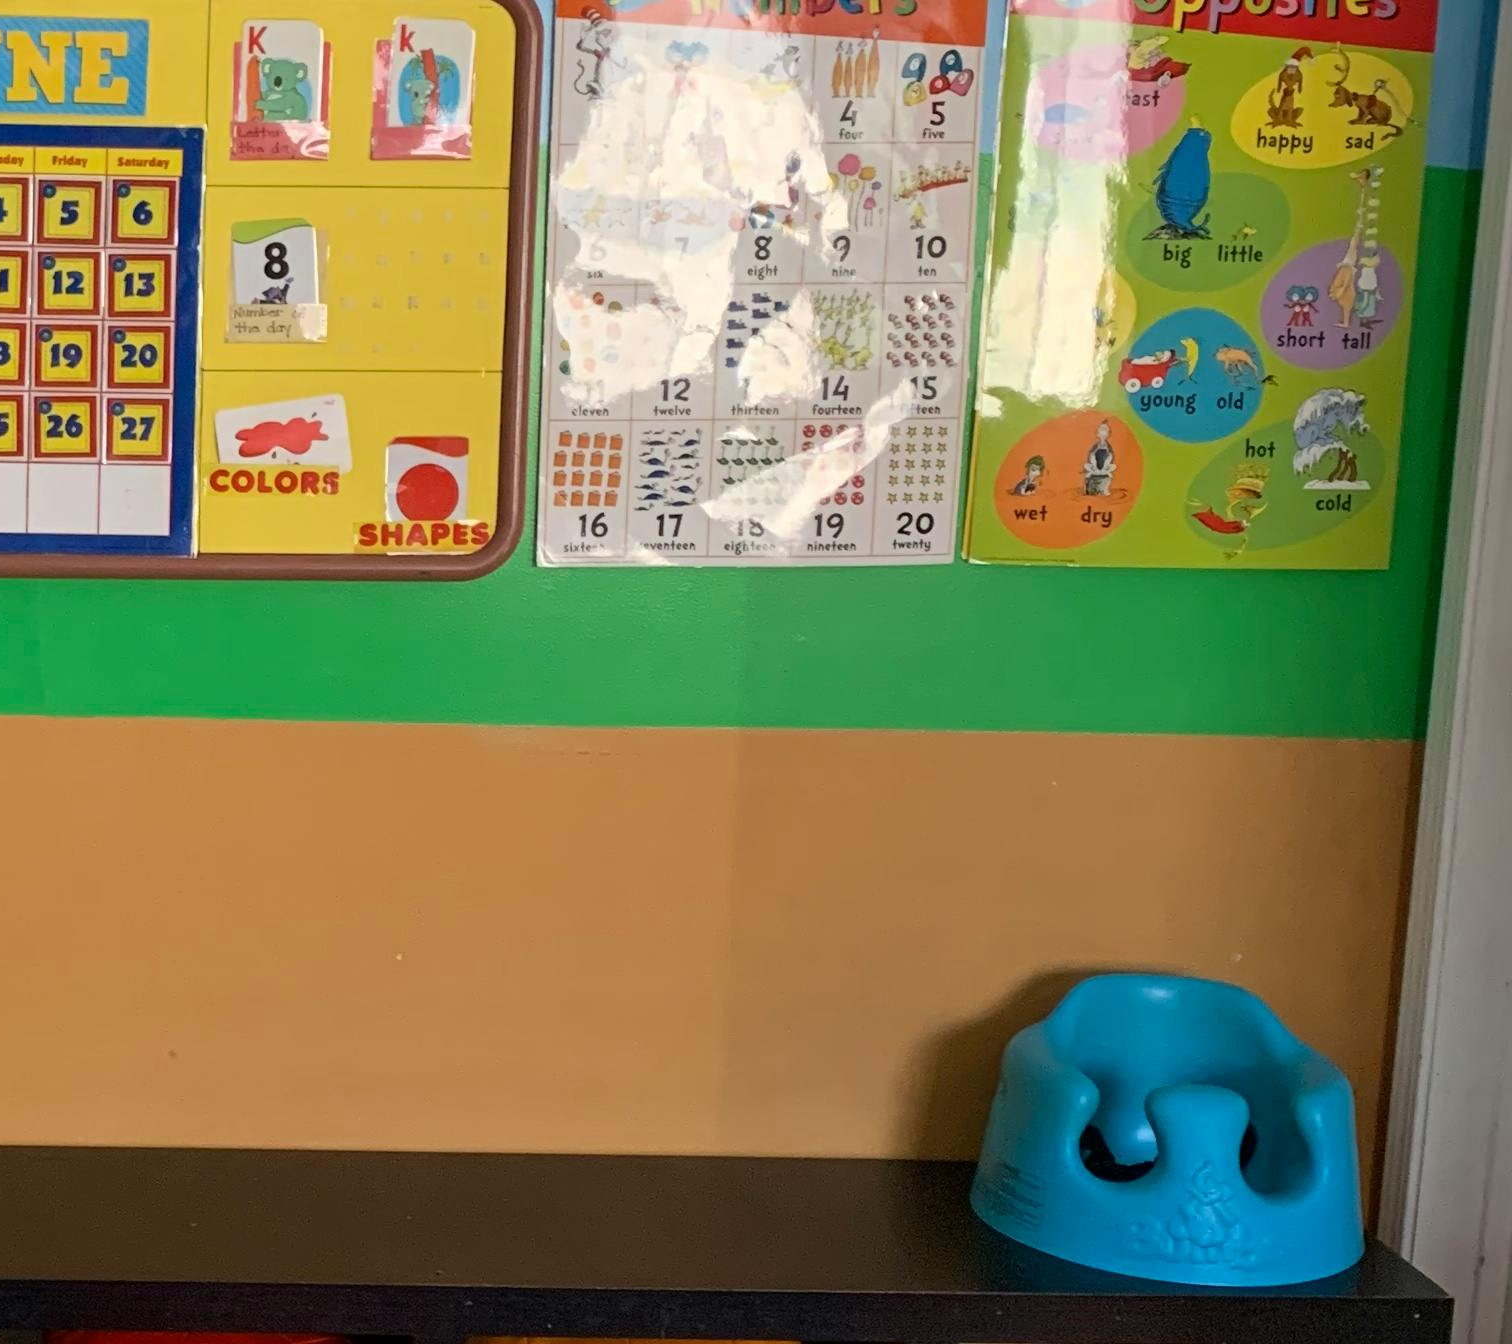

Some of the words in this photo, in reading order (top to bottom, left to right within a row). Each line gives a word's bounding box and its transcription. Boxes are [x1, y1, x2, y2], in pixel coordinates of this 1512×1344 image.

[248, 27, 268, 54] K
[399, 25, 416, 52] k
[840, 100, 857, 126] 4
[930, 102, 945, 126] 5
[839, 129, 863, 140] four
[922, 128, 945, 139] five
[1257, 129, 1313, 154] happy
[1345, 133, 1374, 150] sad
[51, 155, 89, 169] Friday
[117, 157, 169, 170] Saturday
[60, 200, 79, 225] 5
[755, 237, 773, 260] 8
[1163, 245, 1191, 268] big
[1218, 245, 1262, 262] little
[264, 242, 289, 280] 8
[747, 265, 777, 279] eight
[1277, 331, 1324, 348] short
[1343, 332, 1370, 349] tall
[1141, 393, 1196, 413] young
[1217, 393, 1244, 410] old
[1246, 440, 1275, 457] hot
[210, 470, 339, 495] COLORS
[1316, 495, 1351, 512] cold
[578, 513, 608, 537] 16
[815, 514, 844, 538] 19
[897, 513, 934, 535] 20
[1015, 506, 1047, 521] wet
[1081, 507, 1112, 527] dry
[359, 523, 489, 546] SHAPES
[893, 539, 931, 552] twenty
